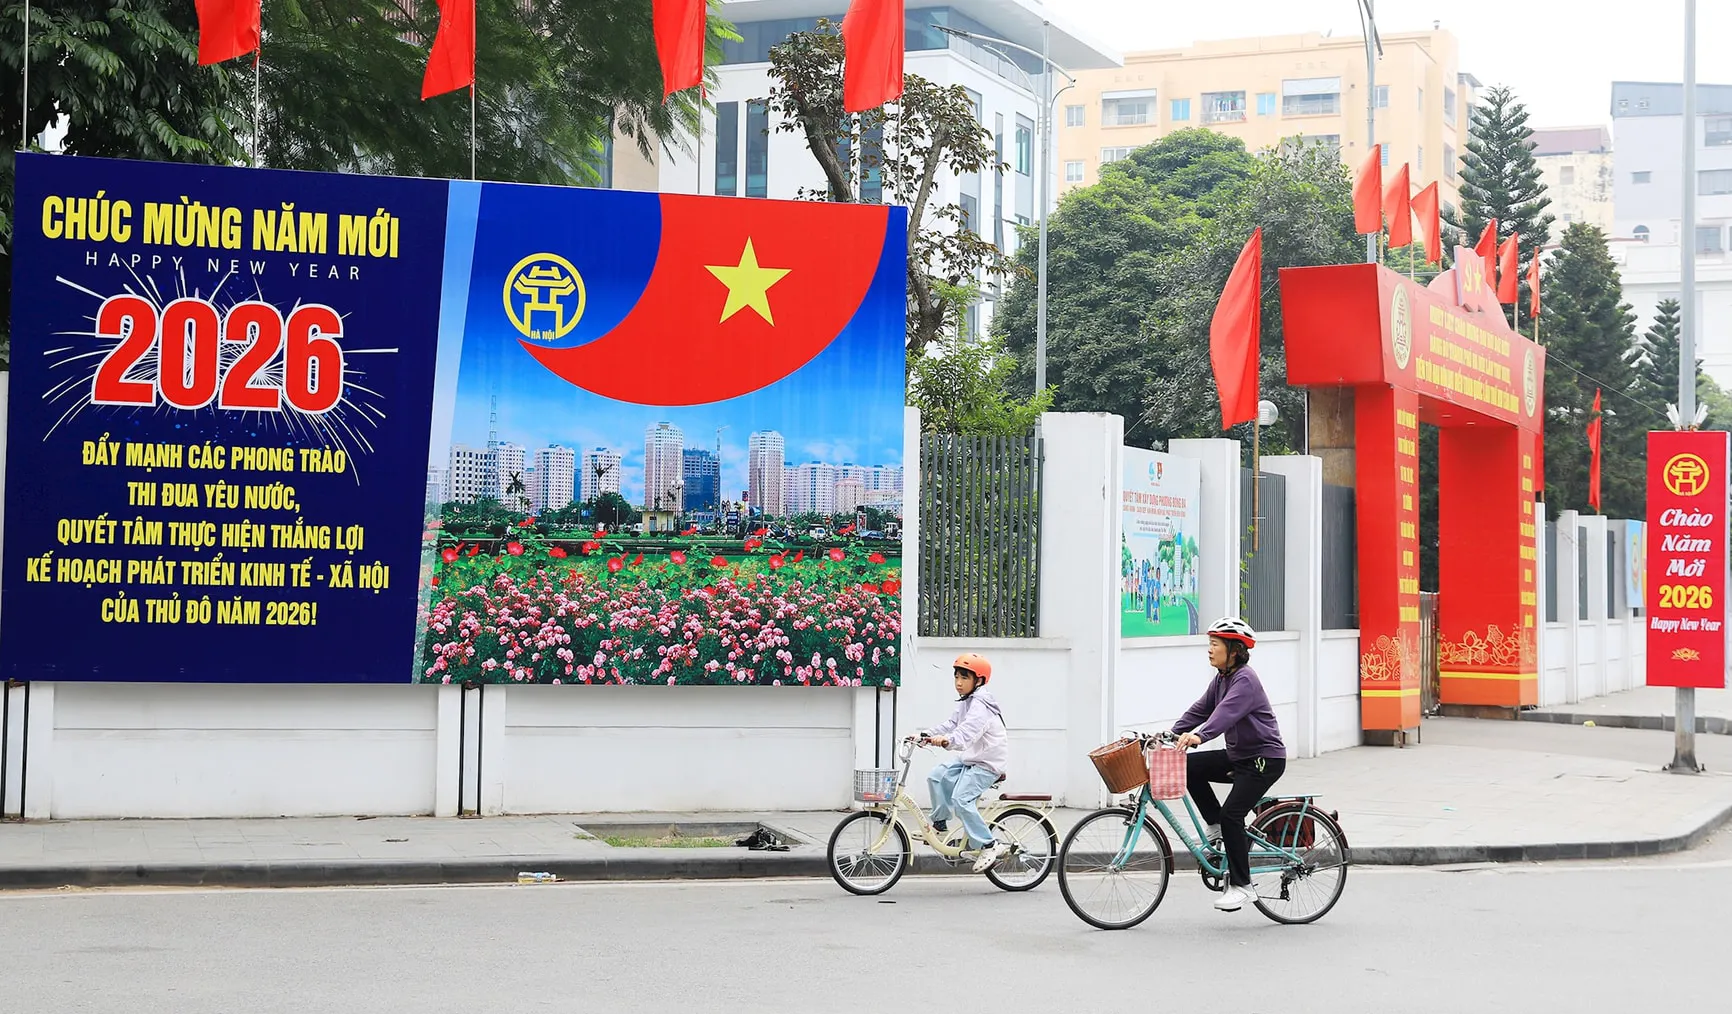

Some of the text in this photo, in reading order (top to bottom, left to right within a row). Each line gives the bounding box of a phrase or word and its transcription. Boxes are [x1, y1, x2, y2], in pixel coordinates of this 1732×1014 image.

[43, 191, 398, 257] CHÚC MỪNG NĂM MỚI
[86, 251, 360, 280] HAPPY NEW YEAR
[531, 329, 555, 342] HÀ NỘI
[91, 294, 344, 414] 2026
[83, 433, 345, 473] ĐẨY MẠNH CÁC PHONG TRÀO
[128, 480, 299, 512] THI ĐUA YÊU NƯỚC,
[1660, 508, 1713, 526] Chào
[58, 514, 363, 554] QUYẾT TÂM THỰC HIỆN THẮNG LỢI
[1661, 535, 1711, 552] Năm
[27, 551, 53, 582] KẾ
[58, 559, 121, 588] HOẠCH
[128, 556, 176, 584] PHÁT
[181, 553, 235, 585] TRIỂN
[241, 563, 285, 586] KINH
[291, 557, 313, 587] TẾ
[330, 561, 353, 587] XÃ
[359, 561, 389, 593] HỘI
[1666, 559, 1706, 576] Mới
[102, 592, 316, 625] CỦA THỦ ĐÔ NĂM 2026!
[1660, 585, 1712, 608] 2026
[1651, 617, 1721, 633] Happy New Year
